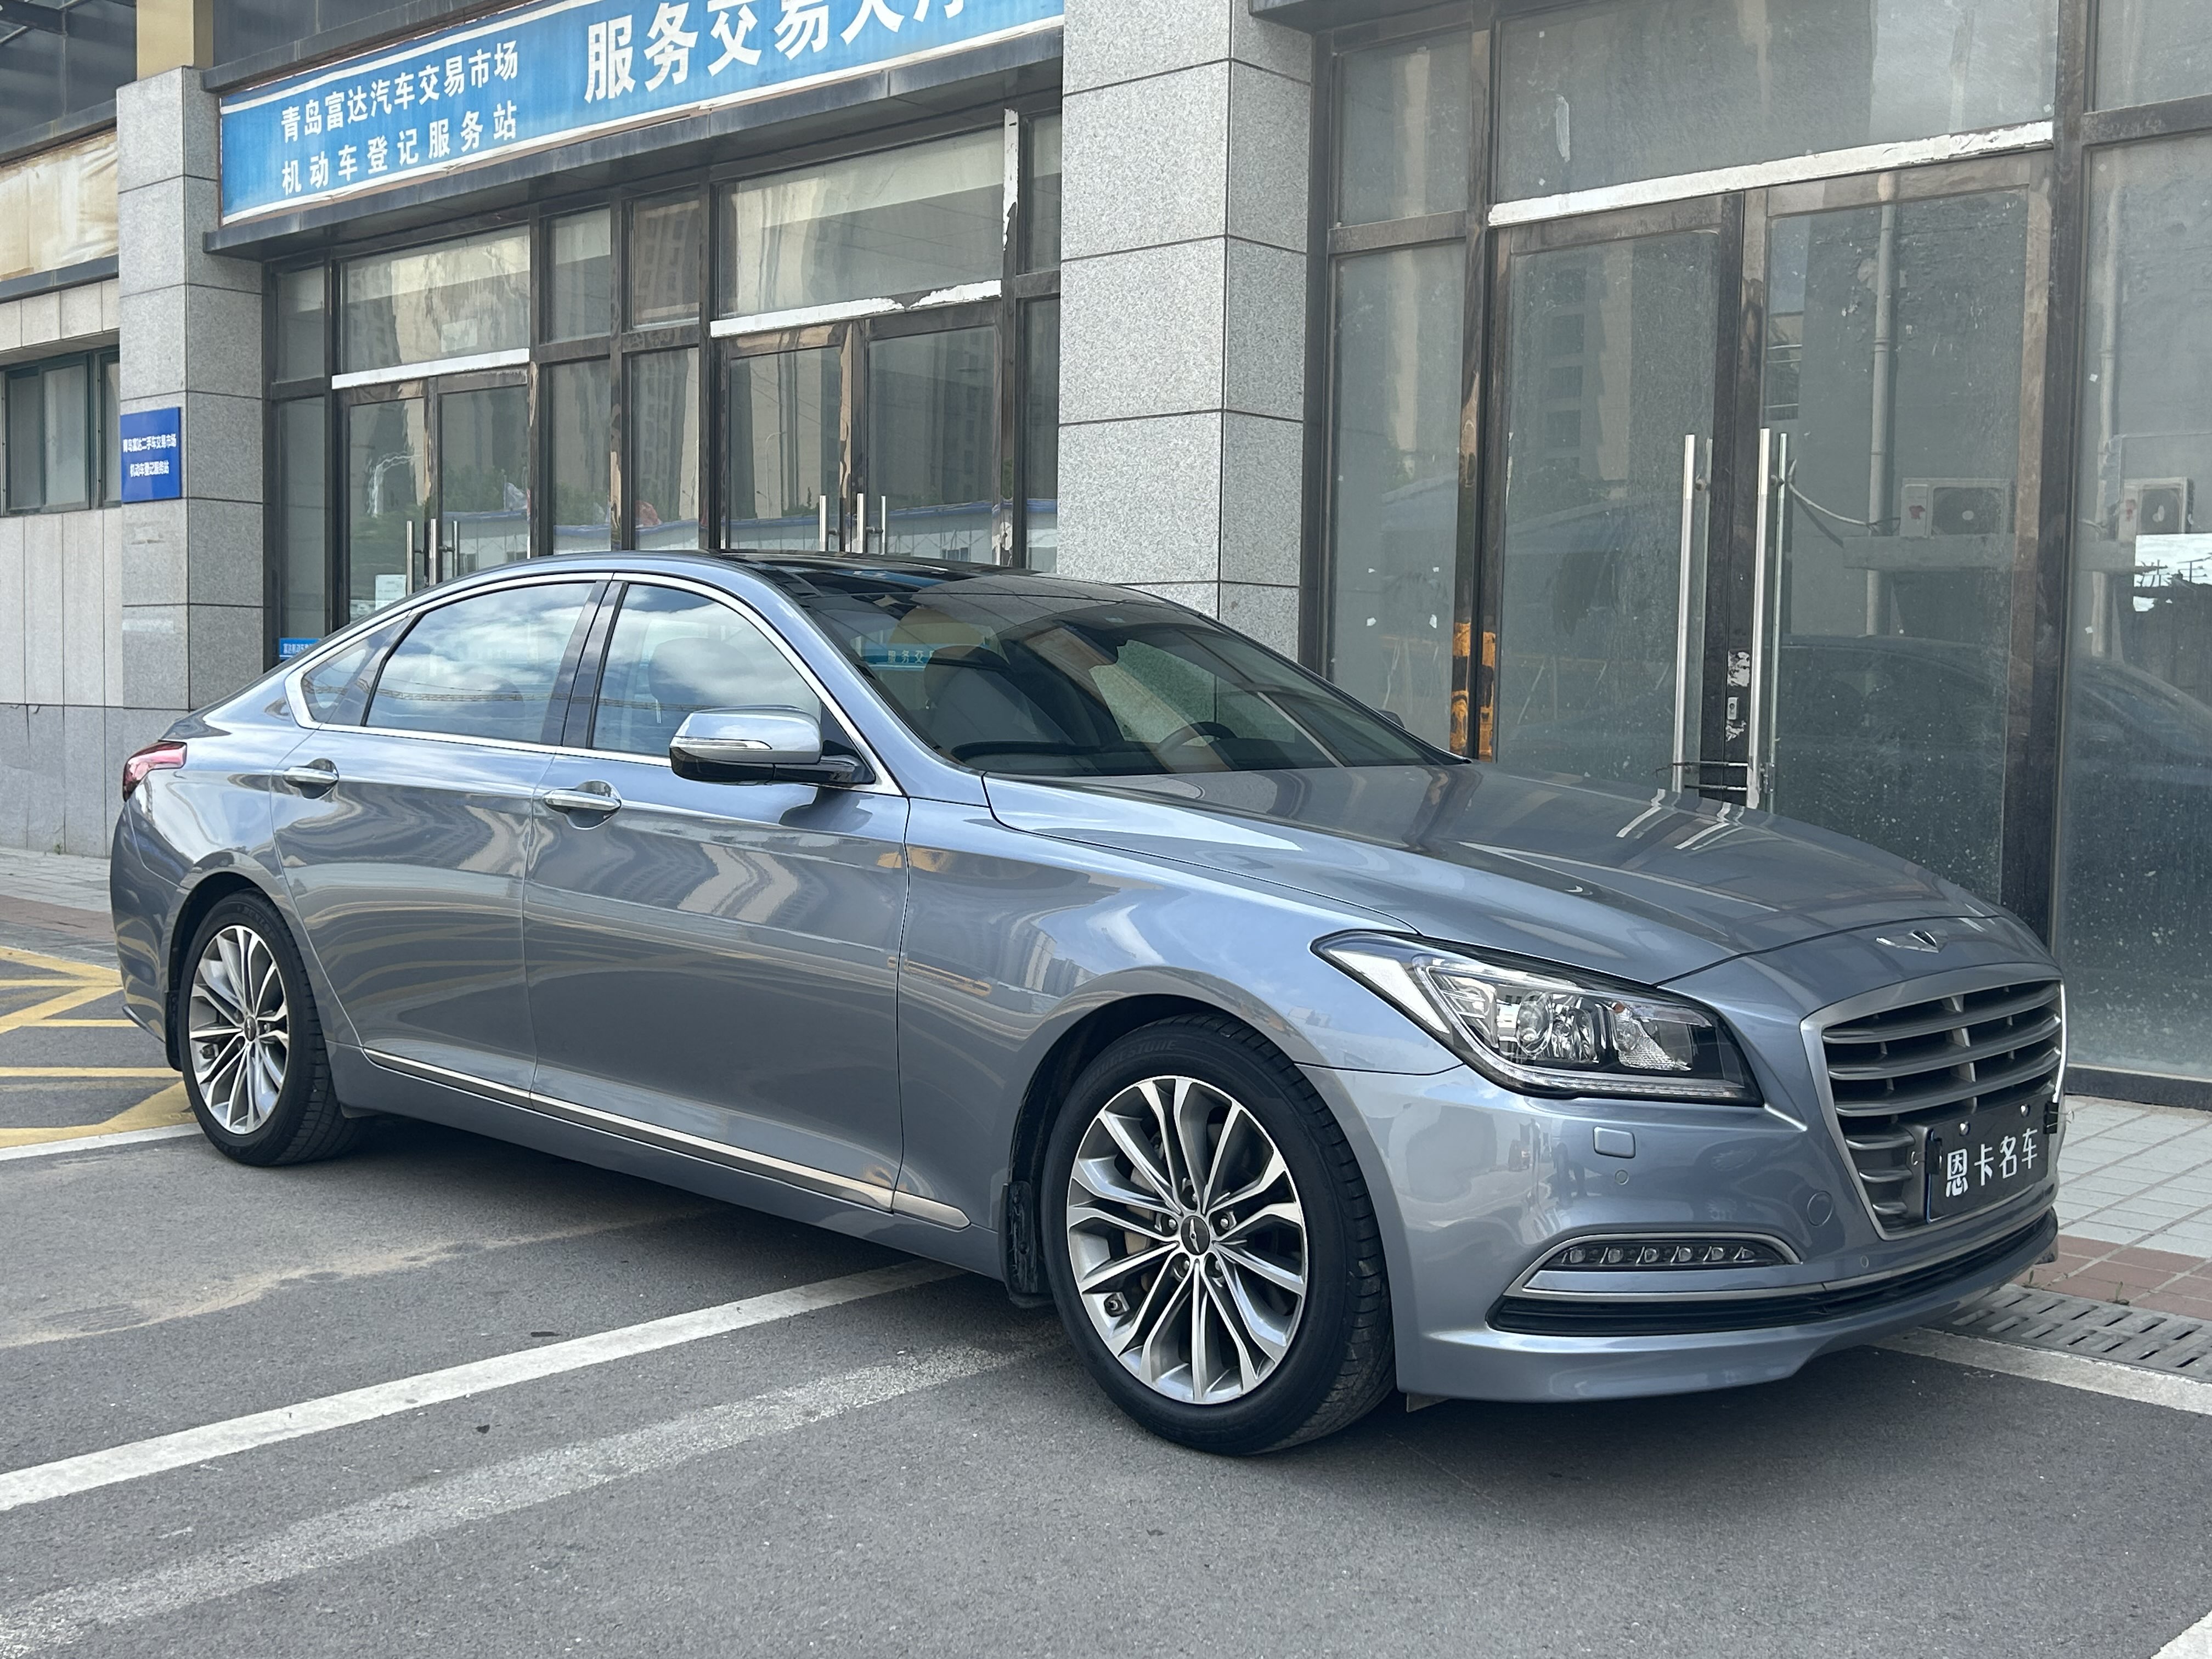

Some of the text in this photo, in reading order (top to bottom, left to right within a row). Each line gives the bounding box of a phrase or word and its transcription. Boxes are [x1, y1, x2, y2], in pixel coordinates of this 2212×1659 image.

[281, 40, 518, 143] 青岛富达汽车交易市场
[584, 0, 964, 103] 服务交易
[282, 100, 517, 196] 机动车登记服务站
[1945, 1127, 2039, 1198] 恩卡名车
